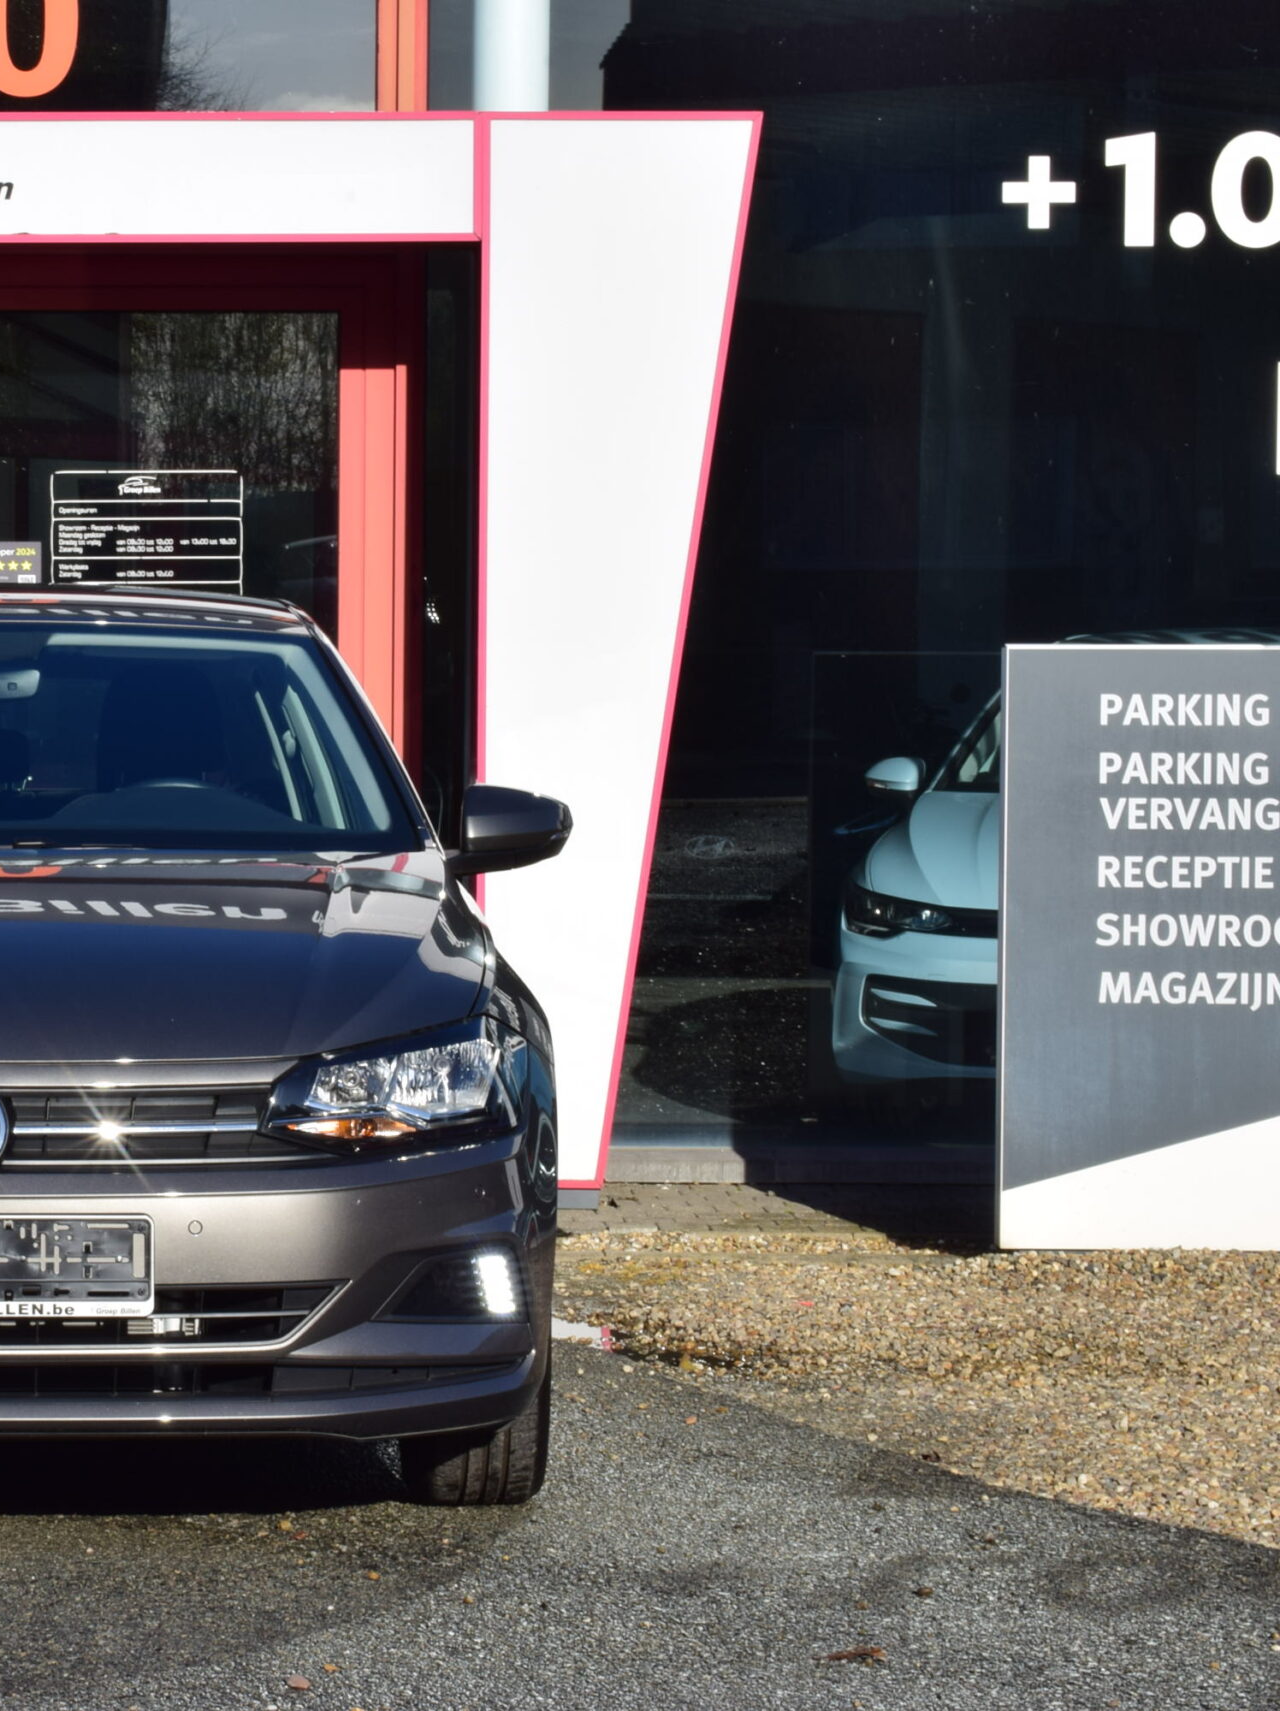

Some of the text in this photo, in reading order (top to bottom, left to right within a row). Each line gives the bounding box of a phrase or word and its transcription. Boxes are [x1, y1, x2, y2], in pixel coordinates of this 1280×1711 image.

[1100, 693, 1270, 727] PARKING
[1099, 752, 1269, 785] PARKING
[1100, 797, 1280, 831] VERVANG
[1098, 855, 1274, 889] RECEPTIE
[1096, 913, 1280, 948] SHOWRO
